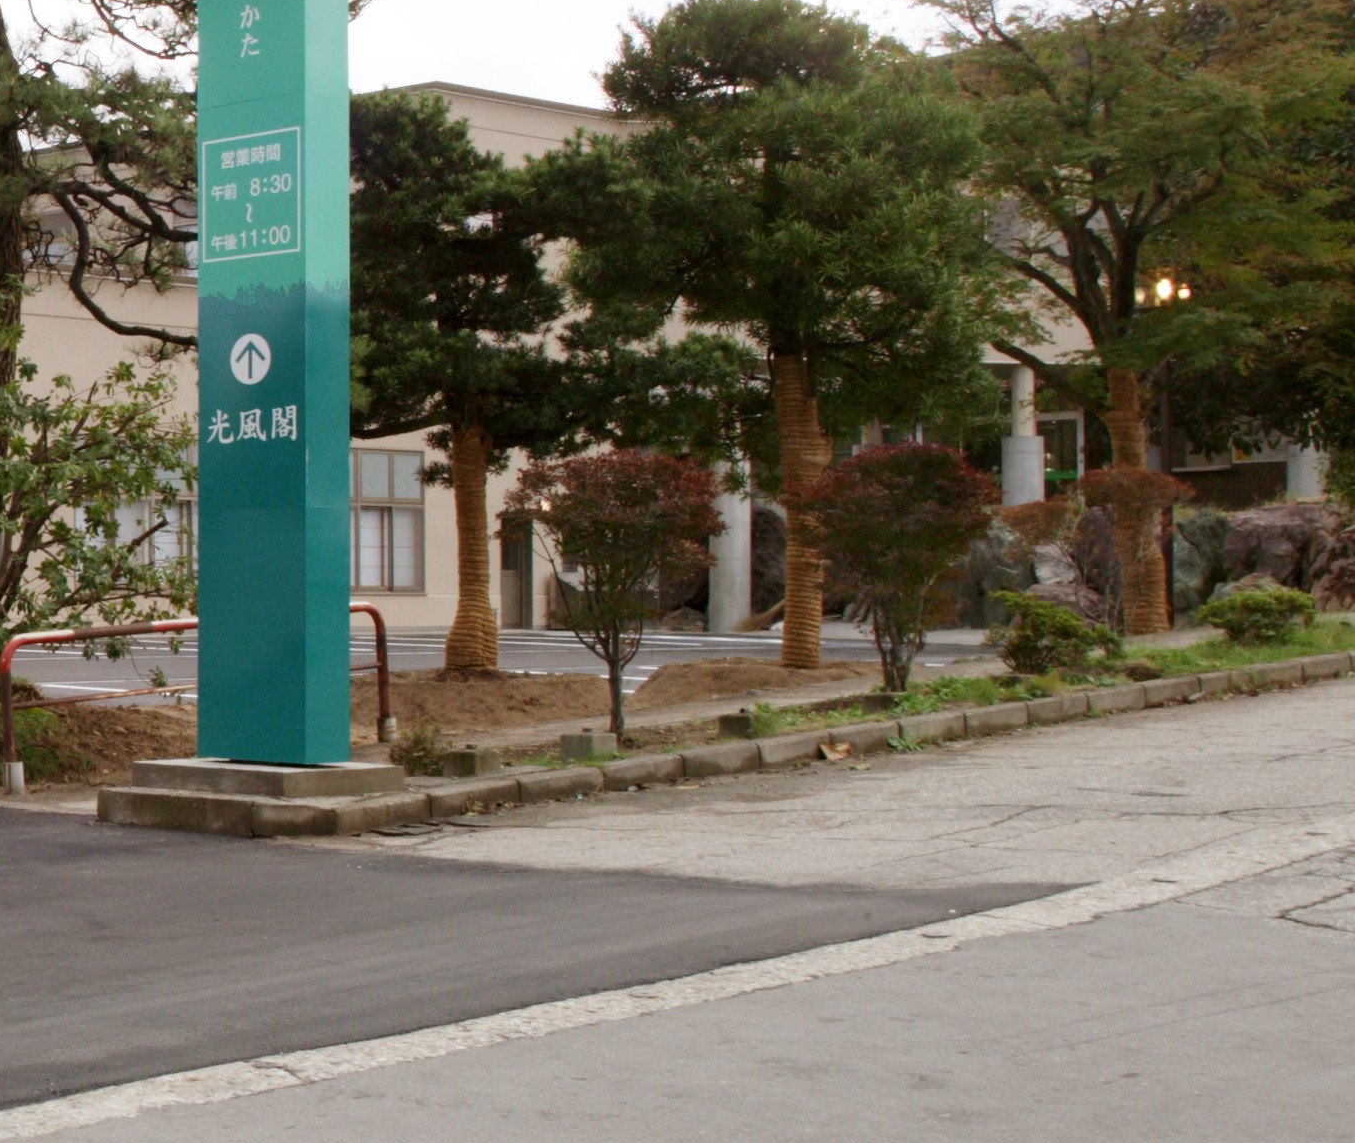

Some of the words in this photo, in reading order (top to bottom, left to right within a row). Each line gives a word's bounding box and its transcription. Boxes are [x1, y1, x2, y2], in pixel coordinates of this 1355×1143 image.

[220, 143, 281, 170] 営業時間
[211, 183, 237, 202] 午前
[249, 173, 292, 197] 8:30
[206, 404, 297, 444] 光風閣
